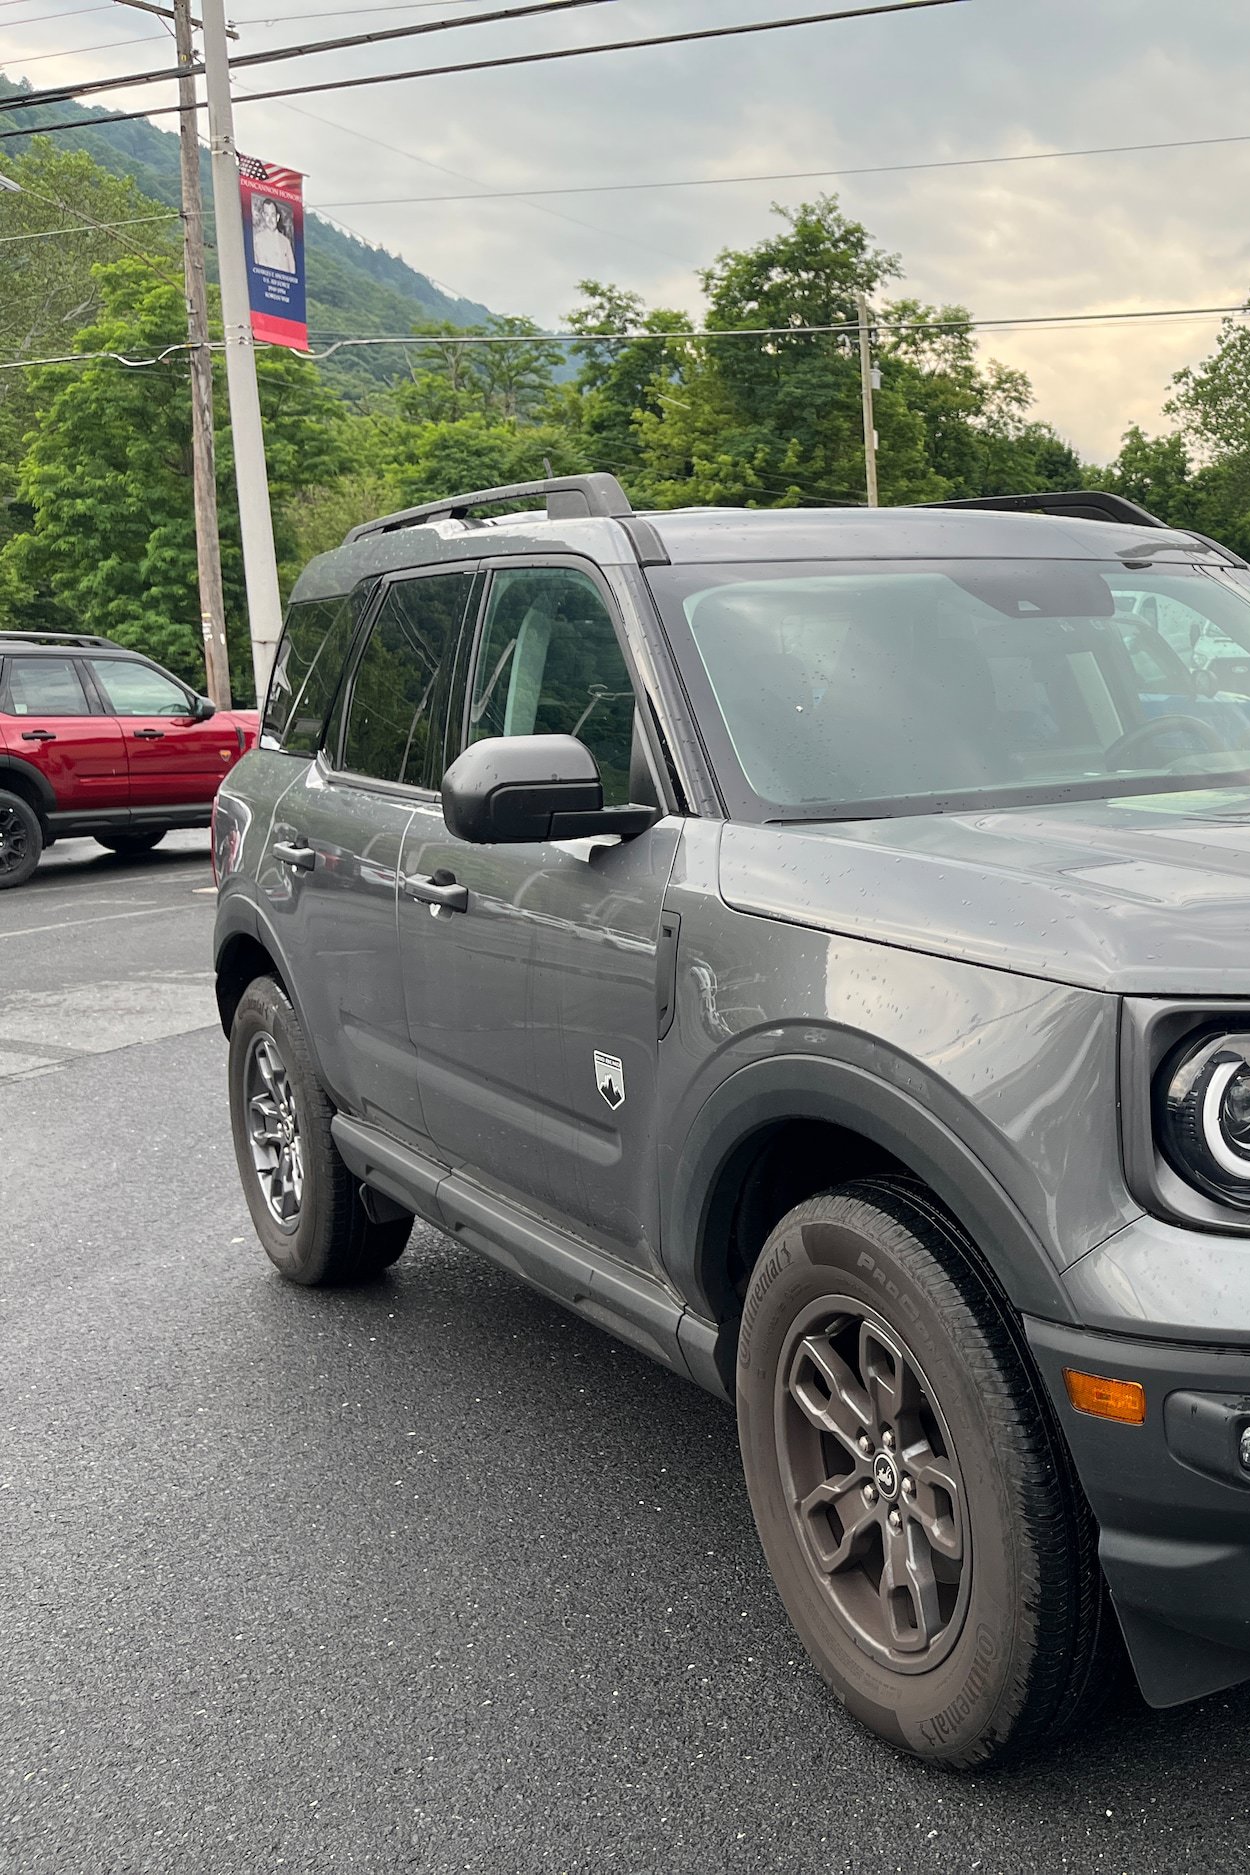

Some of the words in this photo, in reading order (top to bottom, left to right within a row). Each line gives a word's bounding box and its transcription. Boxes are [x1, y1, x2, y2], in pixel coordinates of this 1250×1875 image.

[240, 178, 279, 195] DUNCANNON
[740, 1246, 784, 1370] Continental
[931, 1621, 999, 1745] Continental
